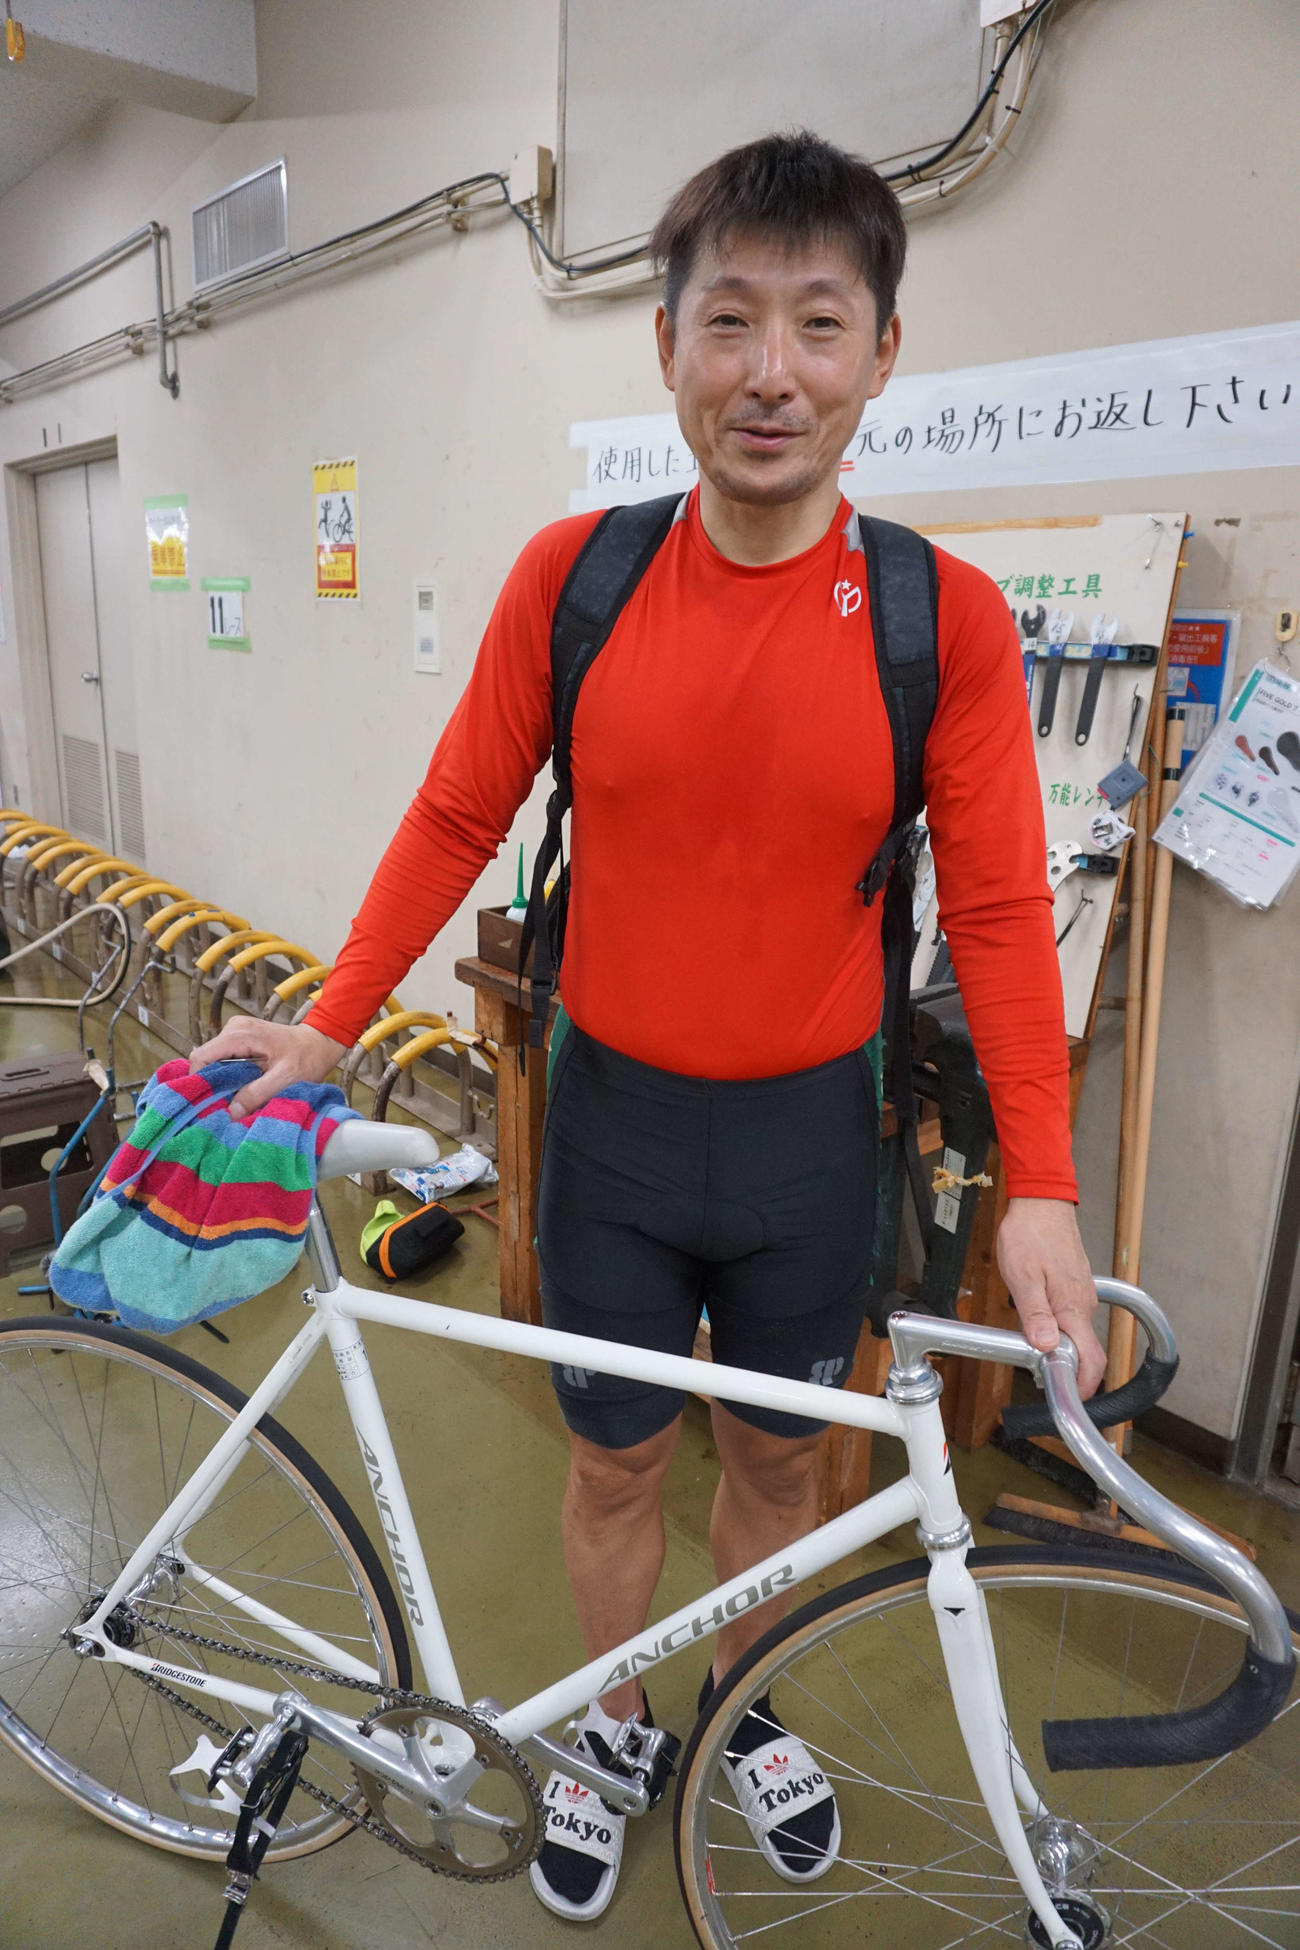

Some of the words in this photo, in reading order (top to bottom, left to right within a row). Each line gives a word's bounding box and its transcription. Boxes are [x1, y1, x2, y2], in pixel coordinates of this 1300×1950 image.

[857, 375, 1291, 456] 元の場所にお返し下さい
[1273, 696, 1293, 709] GOLD
[356, 1426, 424, 1627] ANCHOR
[597, 1564, 797, 1694] ANCHOR
[150, 1662, 208, 1688] BRIDGESTONE
[548, 1780, 561, 1799] I
[747, 1768, 762, 1790] I
[758, 1772, 825, 1813] Tokyo
